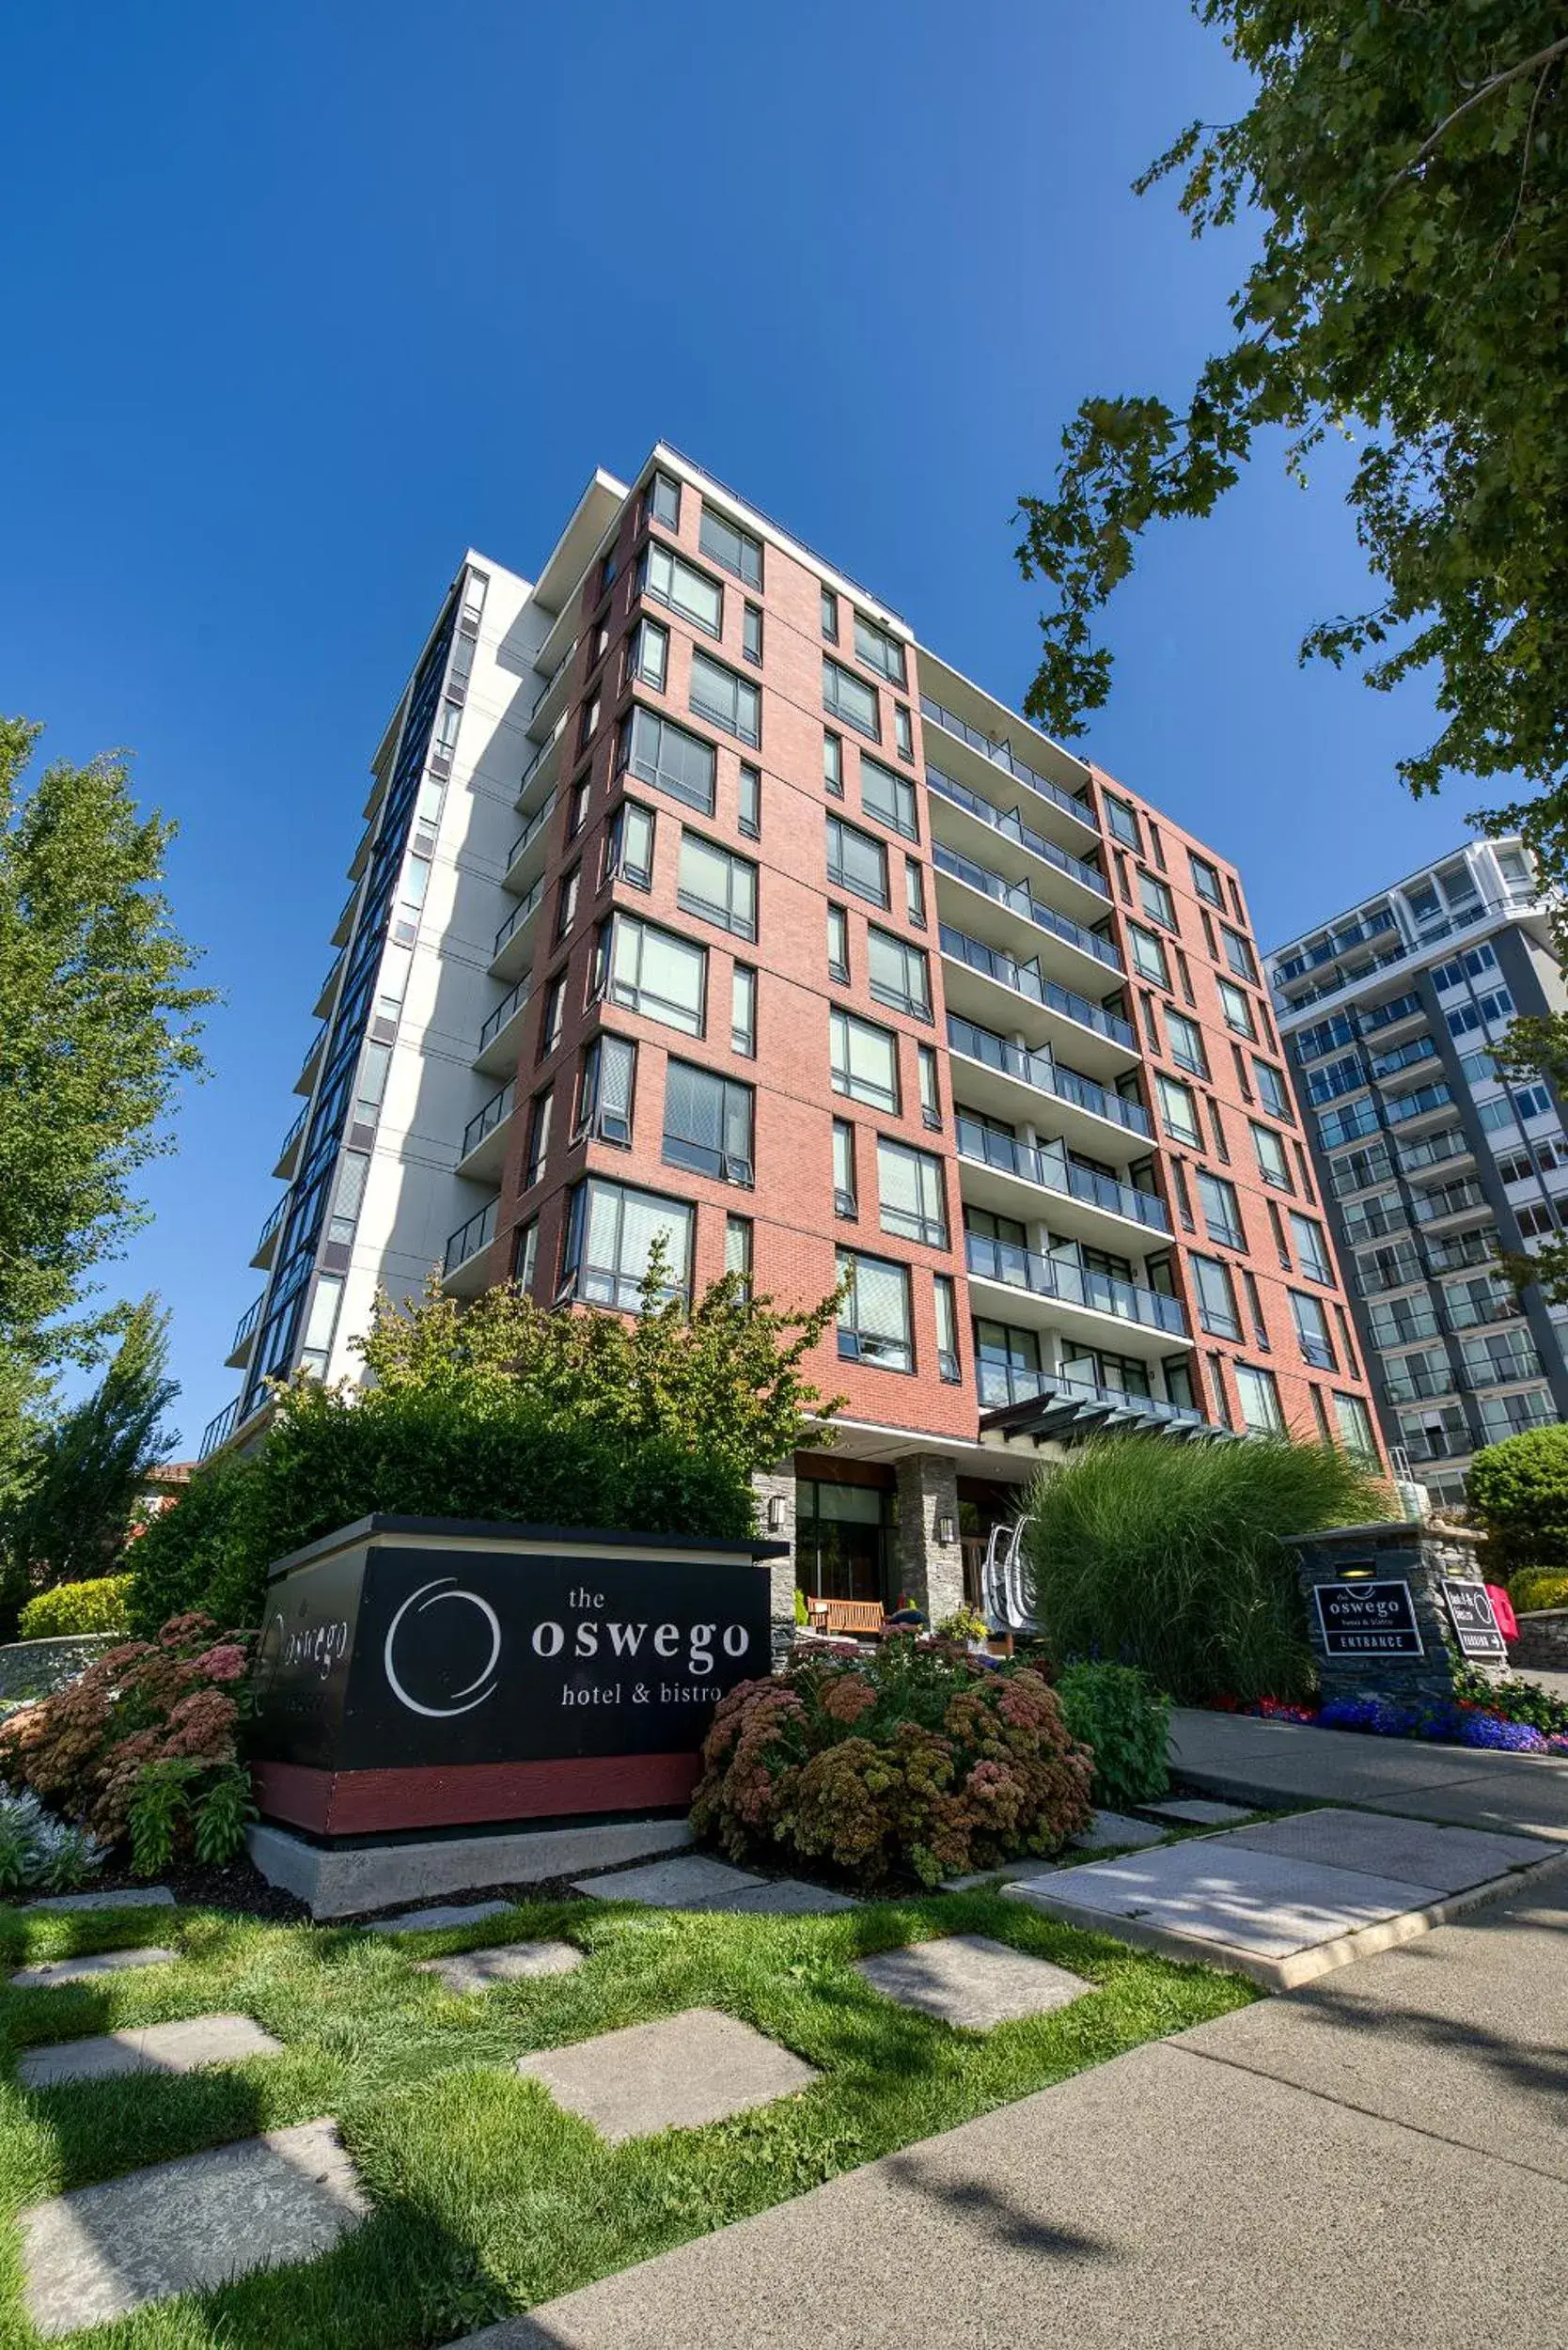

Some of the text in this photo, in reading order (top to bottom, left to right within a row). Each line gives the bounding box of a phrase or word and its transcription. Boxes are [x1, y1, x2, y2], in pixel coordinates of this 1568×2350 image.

[569, 1587, 604, 1608] the
[1329, 1601, 1400, 1618] oswego
[531, 1621, 750, 1676] oswego
[1340, 1636, 1403, 1648] ENTRANCE
[561, 1682, 722, 1706] hotel & bistro
